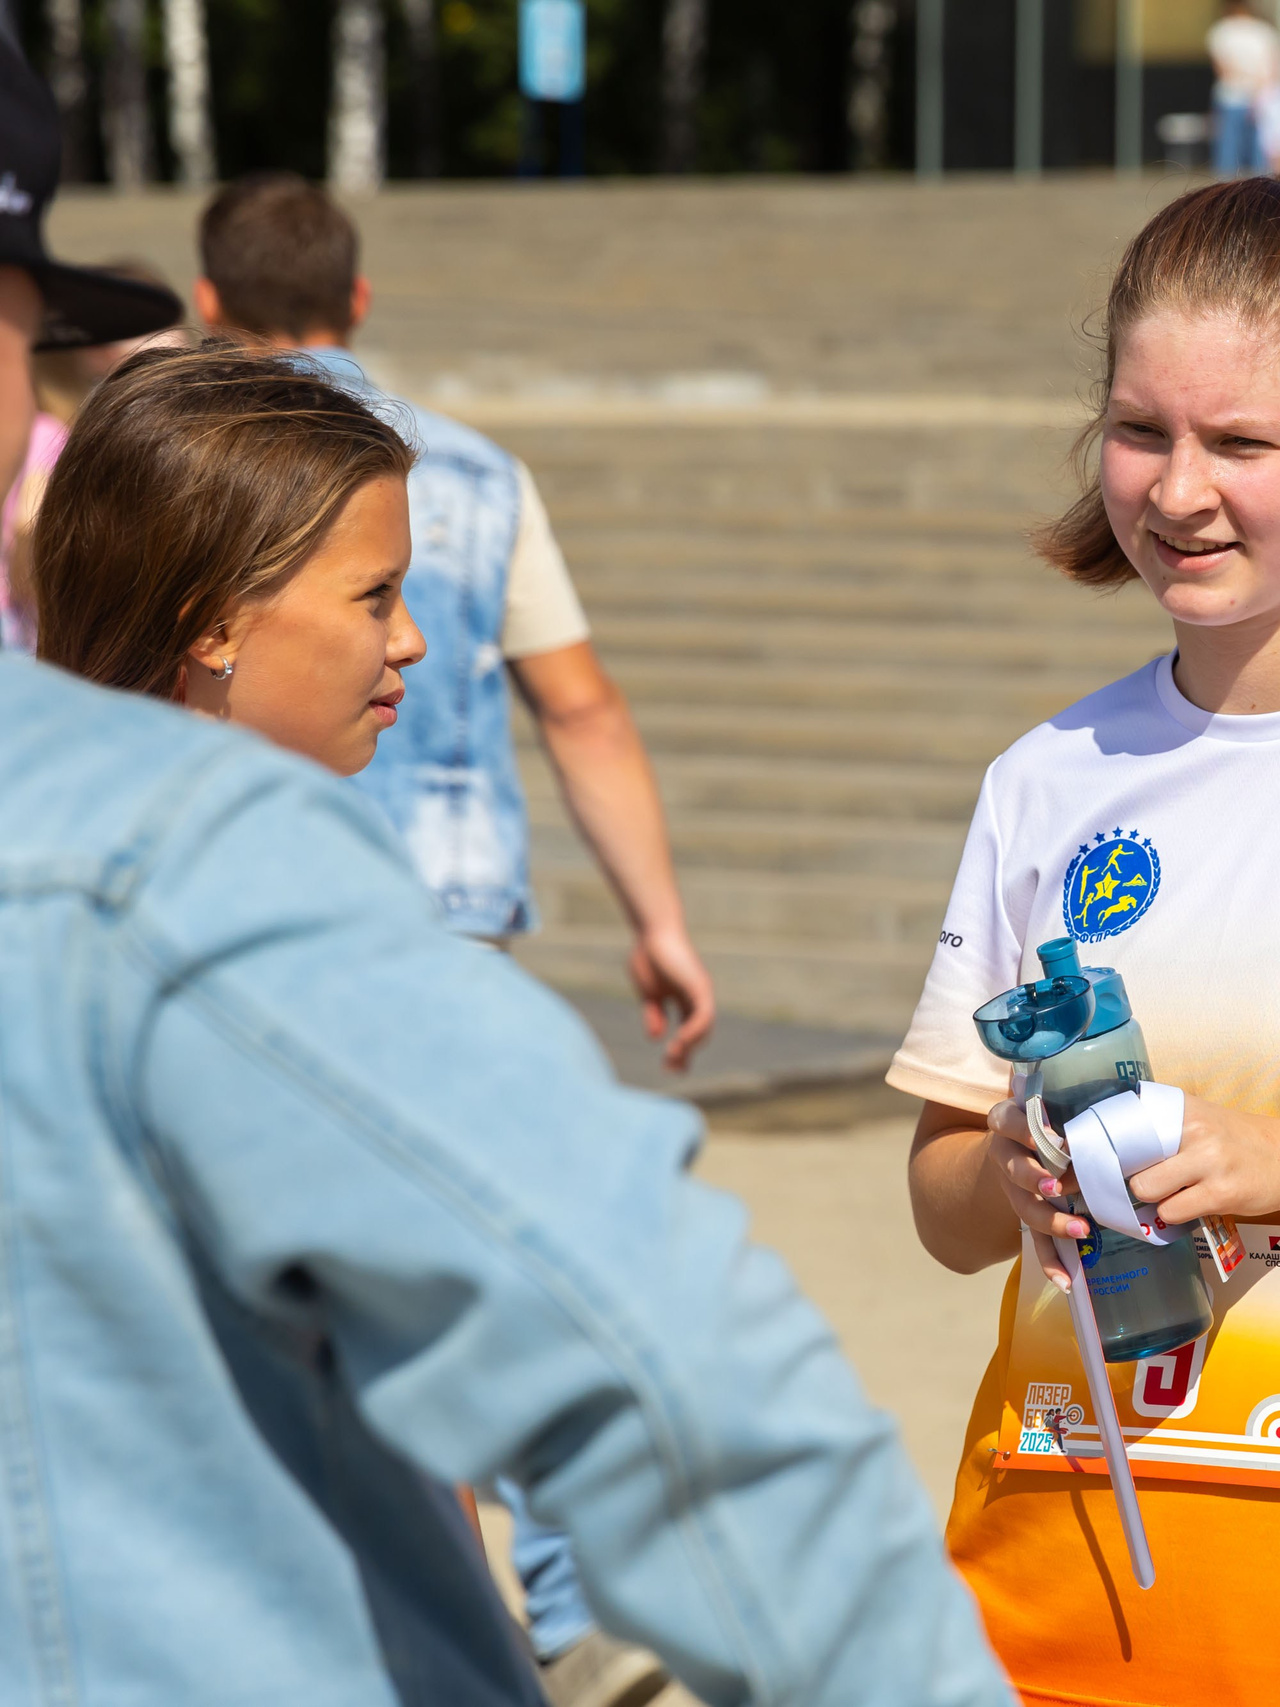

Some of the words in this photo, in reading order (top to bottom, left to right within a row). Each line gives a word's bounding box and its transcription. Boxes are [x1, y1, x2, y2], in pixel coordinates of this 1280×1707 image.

[1079, 929, 1111, 944] ФСПР
[1026, 1385, 1070, 1406] ЛАЗЕР
[1019, 1432, 1053, 1453] 2025
